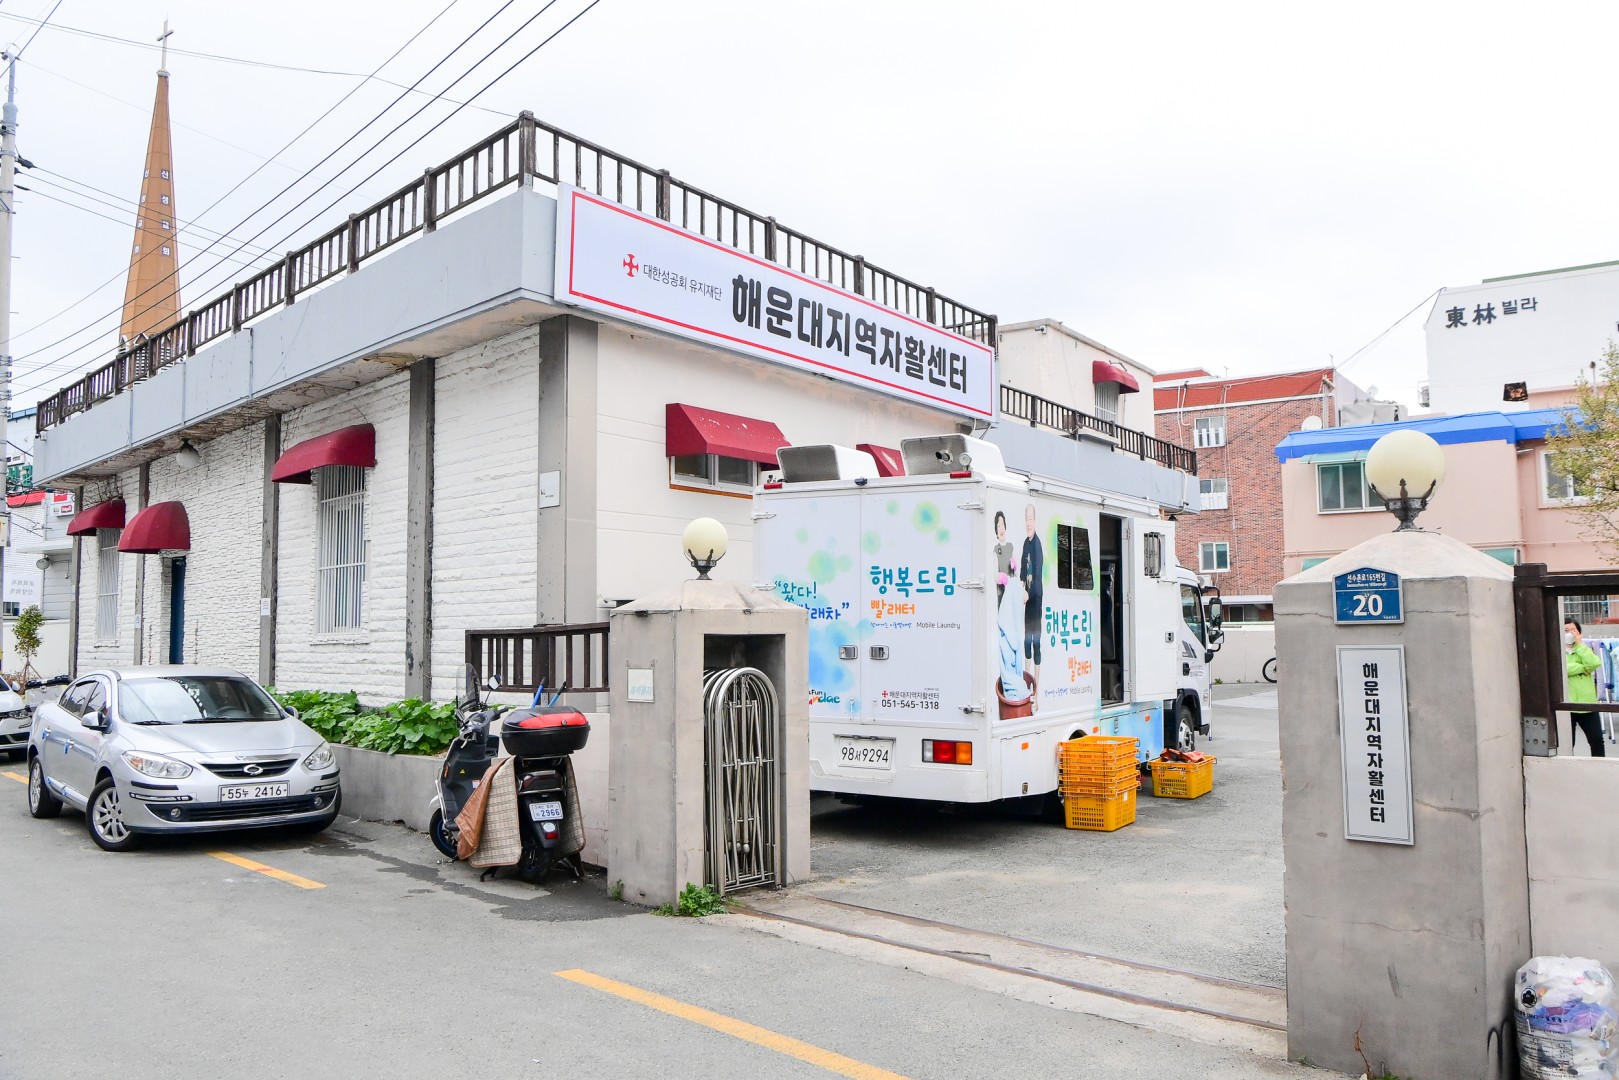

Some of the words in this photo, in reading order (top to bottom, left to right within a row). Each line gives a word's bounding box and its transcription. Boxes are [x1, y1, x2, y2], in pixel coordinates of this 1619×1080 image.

[643, 263, 688, 291] 대한성공회
[689, 279, 723, 301] 유지재단
[1445, 303, 1497, 329] 東林
[1502, 296, 1538, 316] 빌라
[731, 273, 967, 394] 해운대지역자활센터
[869, 565, 957, 598] 행복드림
[870, 599, 916, 619] 빨래터
[1352, 593, 1384, 617] 20
[916, 621, 936, 629] Mobile
[936, 621, 961, 631] Laundry
[1044, 606, 1092, 652] 행복드림
[881, 699, 940, 710] 051-545-1318
[889, 690, 940, 700] 해운대지역자활센터
[1362, 662, 1386, 823] 해운대지역자활센터
[841, 746, 889, 763] 98서9294
[227, 788, 249, 799] 55누
[254, 780, 282, 798] 2416
[540, 808, 561, 817] 2966
